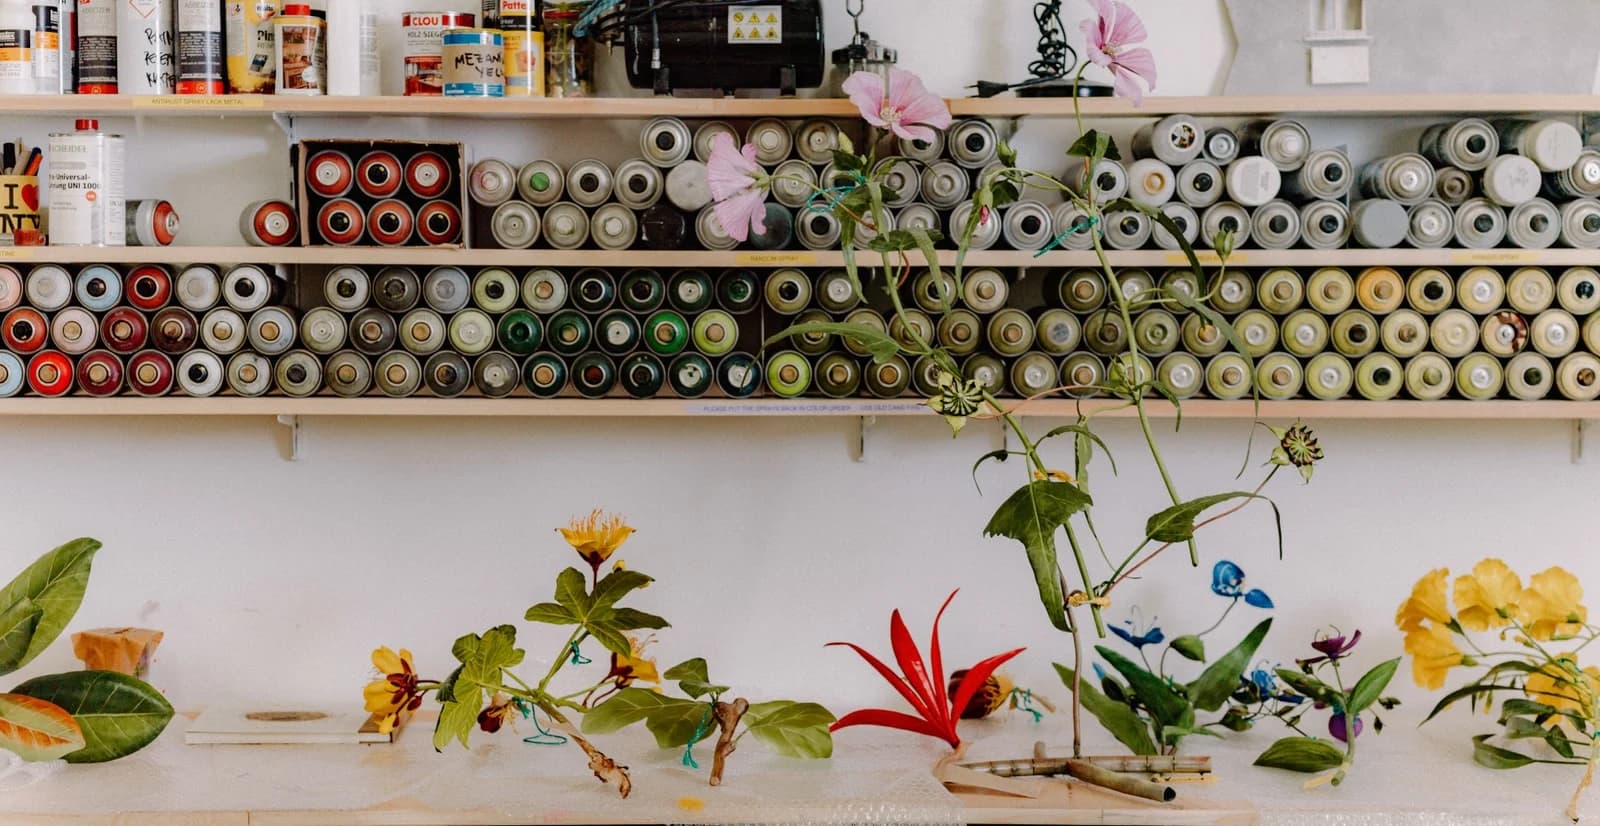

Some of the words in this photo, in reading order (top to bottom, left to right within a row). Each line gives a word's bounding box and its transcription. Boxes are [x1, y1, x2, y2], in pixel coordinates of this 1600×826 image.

[502, 0, 529, 10] Patte
[412, 17, 438, 26] CLOU
[4, 183, 19, 210] I
